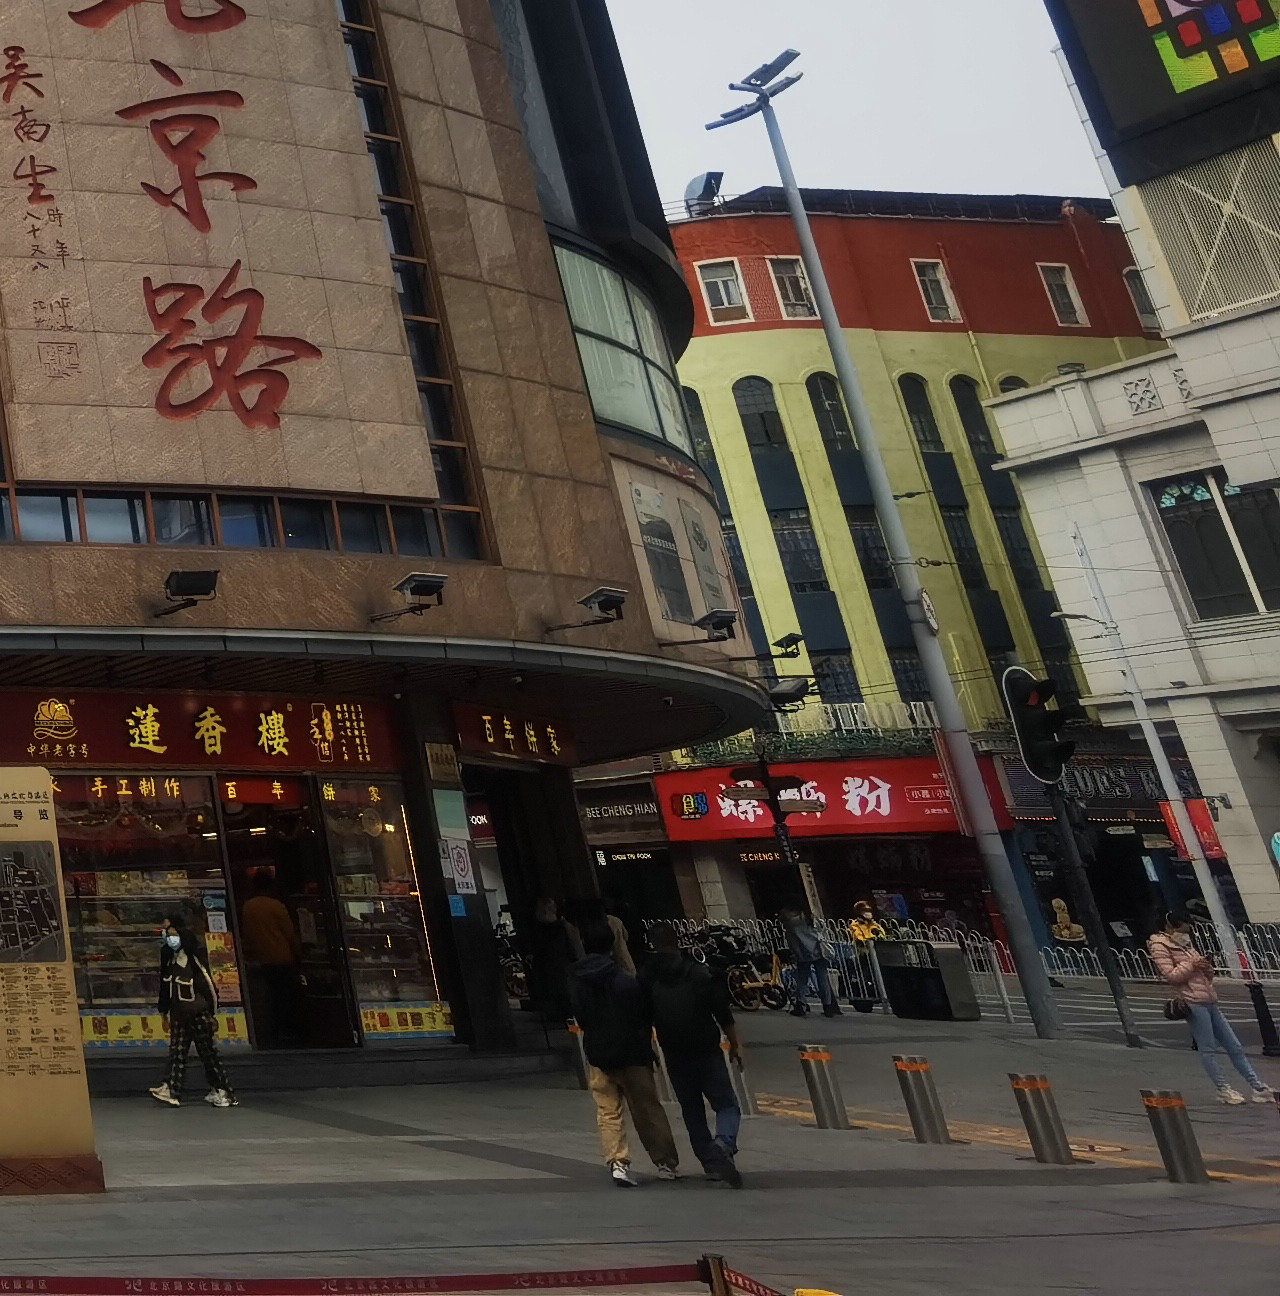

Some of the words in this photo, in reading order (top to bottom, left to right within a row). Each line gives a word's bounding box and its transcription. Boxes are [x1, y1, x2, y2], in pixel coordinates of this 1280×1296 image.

[126, 704, 289, 757] 蓮香樓
[26, 743, 89, 758] 中华老字号
[91, 776, 181, 800] 手工制作
[602, 804, 633, 817] CHENG
[634, 802, 657, 814] HIAN
